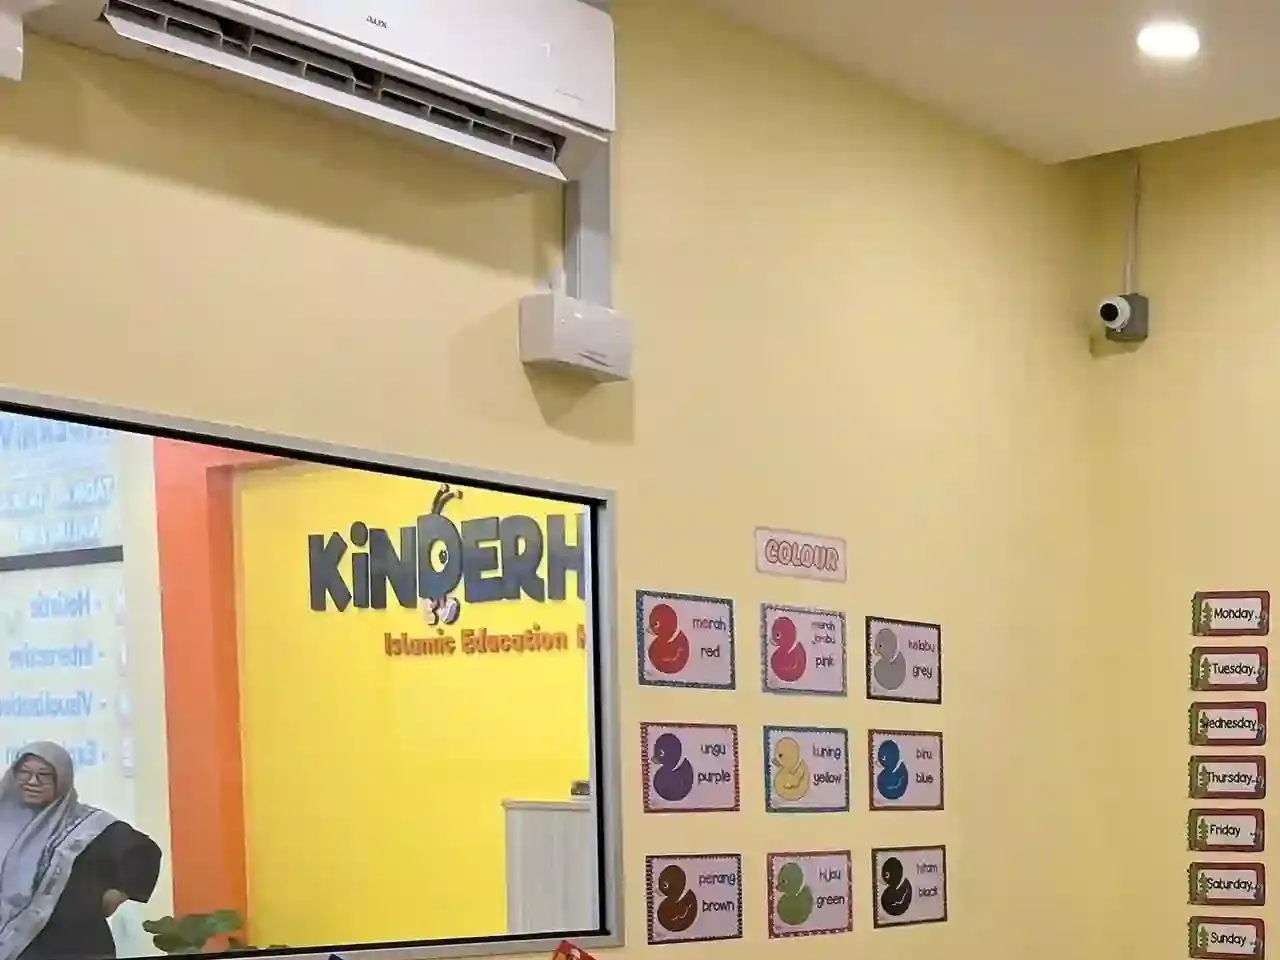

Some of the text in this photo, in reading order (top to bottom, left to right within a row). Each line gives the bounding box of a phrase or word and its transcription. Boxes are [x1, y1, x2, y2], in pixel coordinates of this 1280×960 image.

[764, 538, 840, 572] COLOUR
[1213, 607, 1256, 622] Monday
[692, 615, 727, 632] merah
[384, 628, 457, 657] Islamic
[461, 621, 569, 655] Education
[700, 644, 721, 659] red
[815, 655, 835, 670] pink
[1212, 662, 1254, 677] Tuesday
[912, 663, 933, 680] grey
[1202, 716, 1257, 733] Wednesday
[700, 743, 727, 758] ungu
[915, 747, 933, 760] biru
[697, 769, 731, 785] purple
[812, 771, 842, 787] yellow
[915, 771, 934, 785] blue
[1207, 771, 1253, 787] Thursday
[1209, 824, 1242, 839] Friday
[698, 871, 737, 889] perang
[1207, 877, 1253, 894] Saturday
[701, 899, 735, 914] brown
[816, 894, 846, 909] green
[1210, 931, 1247, 948] Sunday
